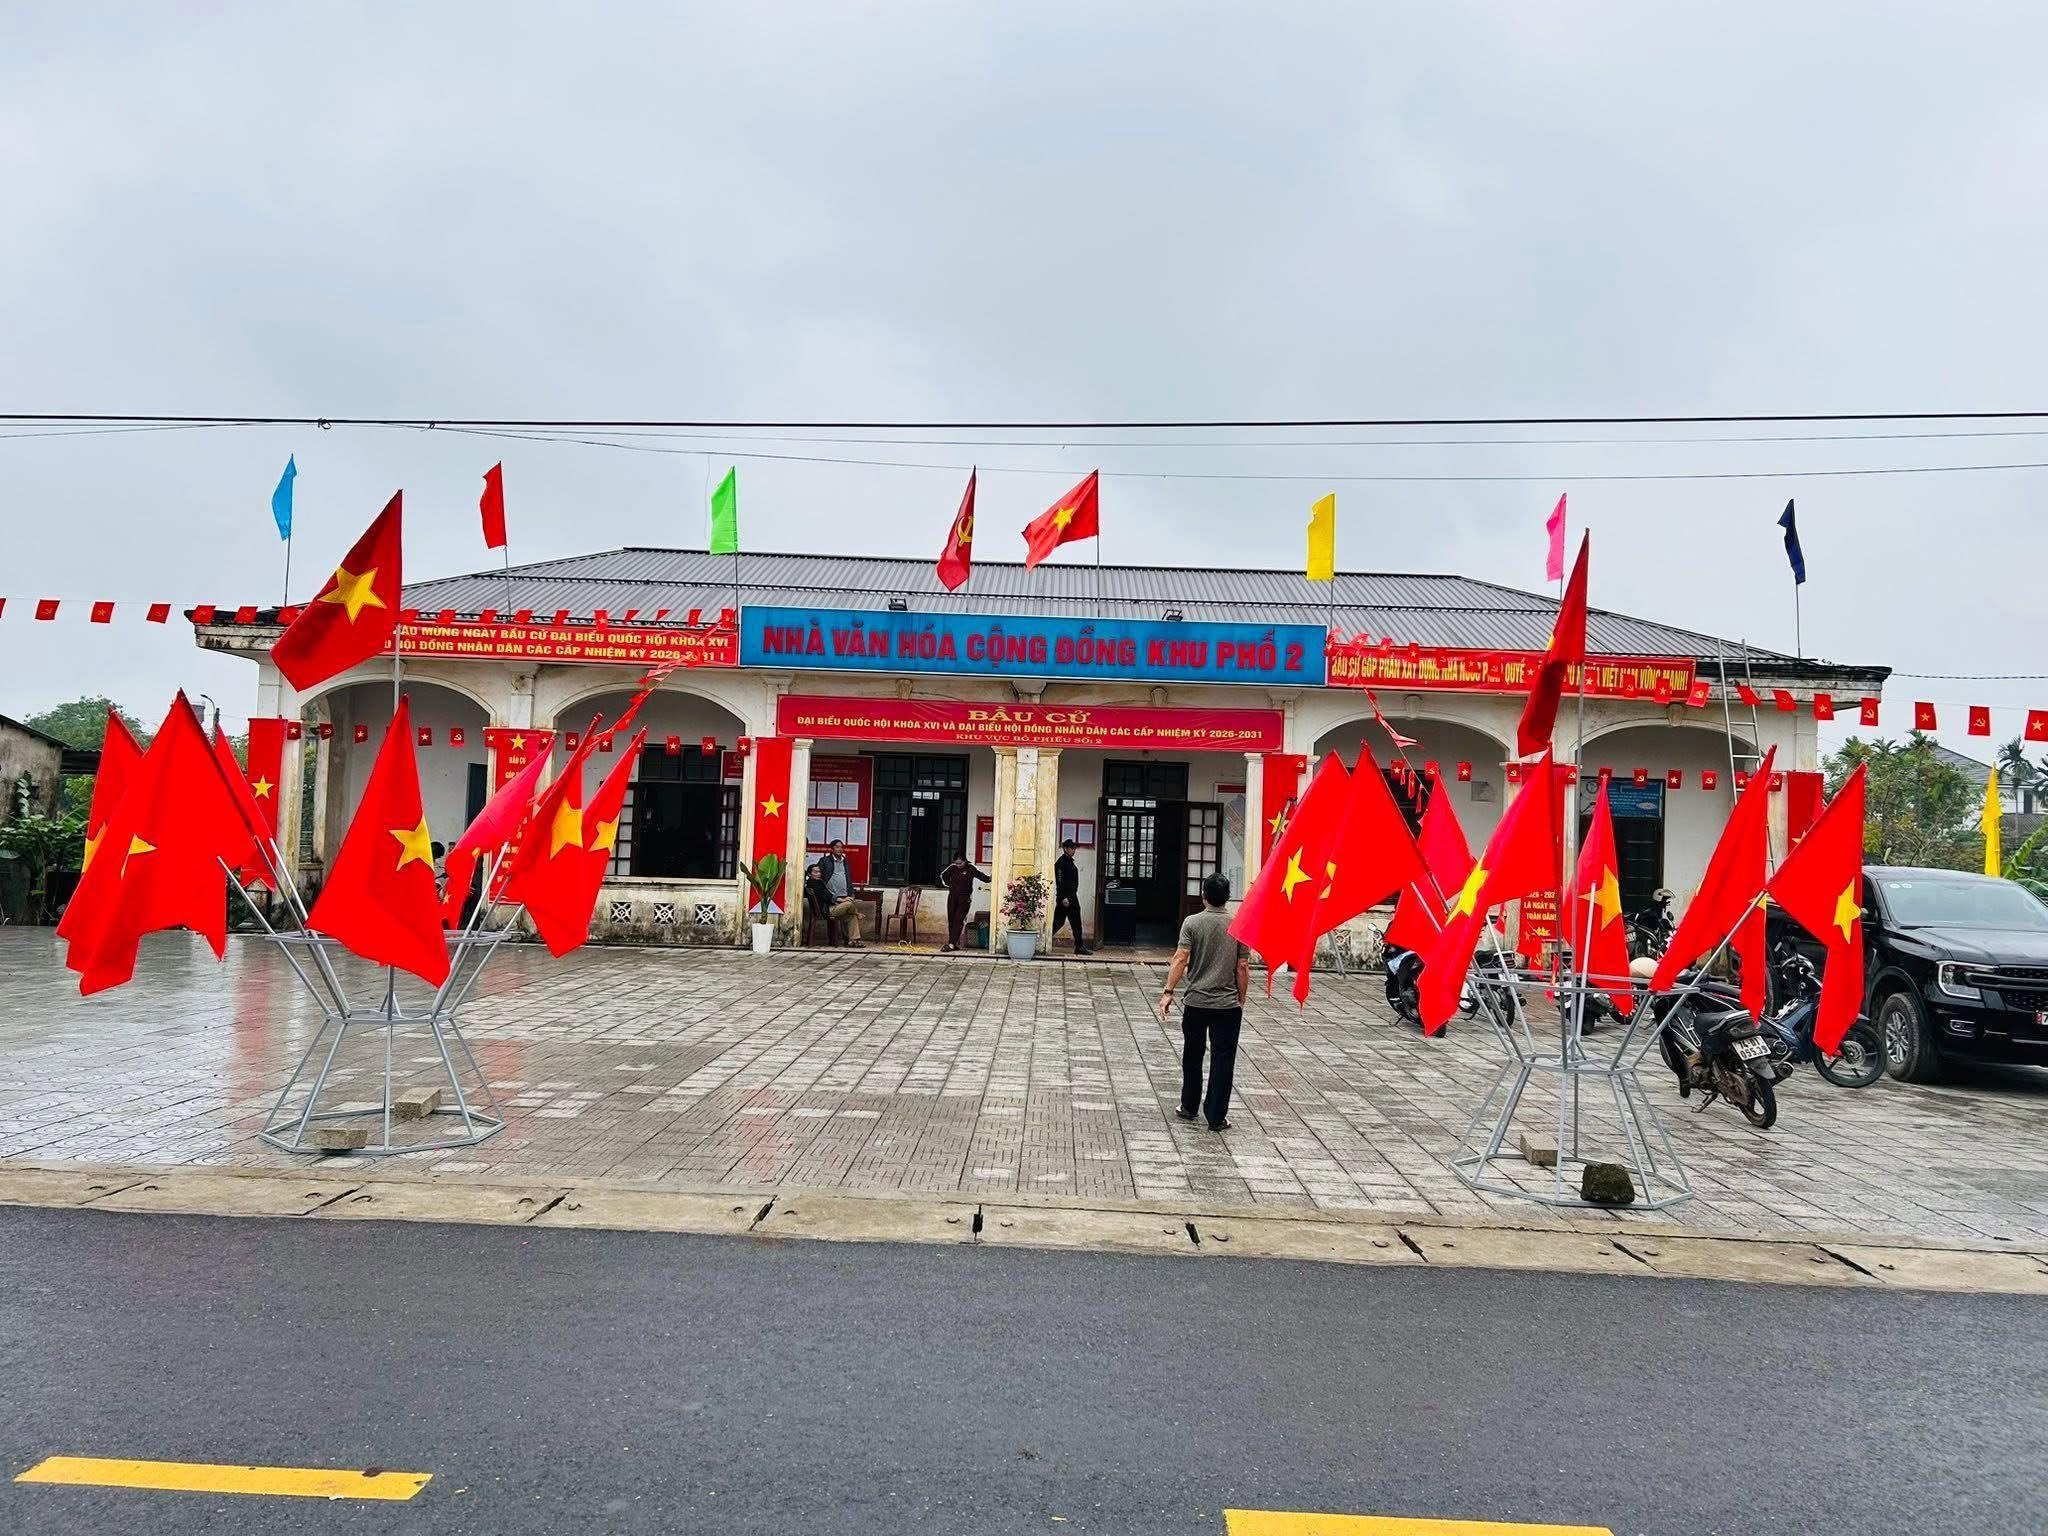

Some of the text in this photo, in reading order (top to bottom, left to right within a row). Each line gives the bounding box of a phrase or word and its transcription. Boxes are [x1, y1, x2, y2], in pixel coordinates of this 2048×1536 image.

[421, 625, 459, 637] MỪNG
[462, 627, 496, 639] NGÀY
[550, 631, 572, 643] ĐẠI
[575, 630, 604, 643] BIỂU
[608, 631, 642, 644] QUỐC
[645, 634, 667, 647] HỘI
[708, 637, 729, 647] XVI
[763, 618, 825, 656] NHÀ
[832, 620, 889, 657] VĂN
[898, 623, 957, 660] HÓA
[967, 625, 1048, 668] CỘNG
[1148, 638, 1208, 668] KHU
[1216, 628, 1277, 671] PHỐ
[1285, 642, 1304, 671] 2
[457, 641, 493, 652] NHÂN
[496, 643, 523, 653] DÂN
[526, 644, 552, 655] CÁC
[556, 644, 581, 655] CẤP
[584, 646, 626, 659] NHIỆM
[650, 649, 714, 661] 2026-231
[1601, 663, 1619, 692] VIỆT
[967, 706, 1091, 724] BẦU CỬ
[797, 716, 815, 726] ĐẠI
[817, 714, 841, 726] BIỂU
[843, 716, 871, 727] QUỐC
[873, 718, 891, 729] HỘI
[923, 721, 940, 730] XVI
[943, 720, 956, 730] VÀ
[958, 722, 975, 733] ĐẠI
[978, 720, 1001, 732] BIỂU
[1004, 723, 1021, 734] HỘI
[1054, 725, 1083, 735] NHÂN
[1086, 726, 1107, 736] DÂN
[1110, 726, 1131, 736] CÁC
[1133, 726, 1154, 737] CẤP
[1157, 727, 1190, 739] NHIỆM
[1193, 728, 1207, 738] KỲ
[1209, 729, 1262, 739] 2026-2031
[956, 733, 982, 741] KHU
[984, 734, 1010, 743] VỰC
